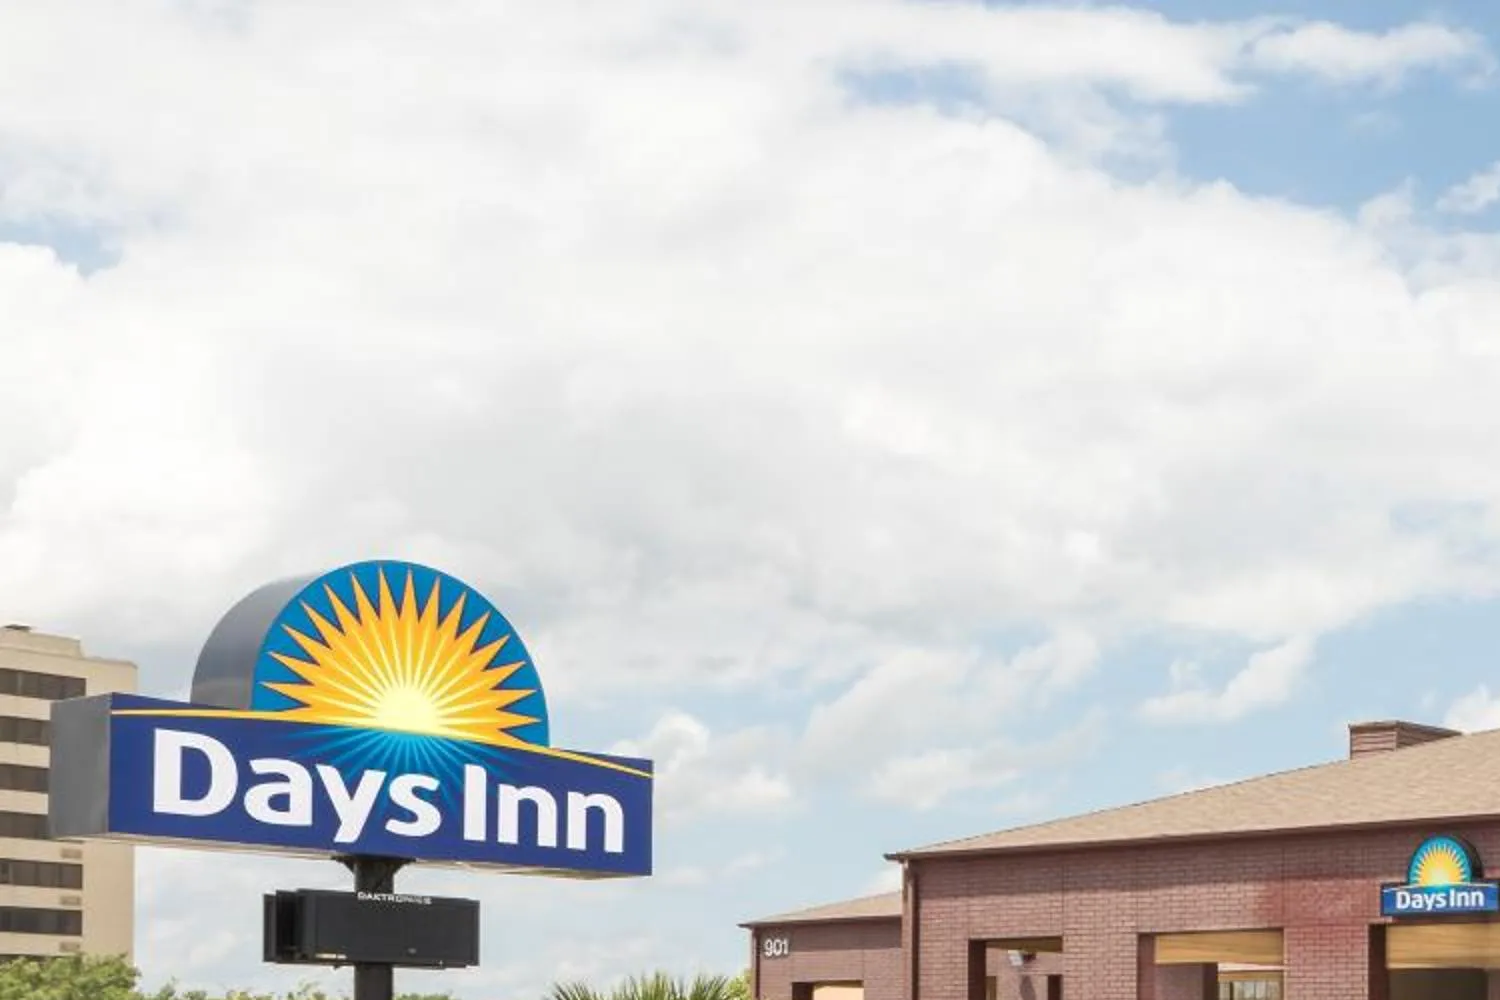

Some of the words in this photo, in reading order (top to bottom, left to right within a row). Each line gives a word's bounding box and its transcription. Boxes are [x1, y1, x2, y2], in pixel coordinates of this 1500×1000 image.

[154, 728, 441, 842] Days
[464, 764, 623, 853] Inn
[1396, 890, 1446, 911] Days
[1449, 889, 1484, 907] Inn
[764, 938, 789, 957] 901
